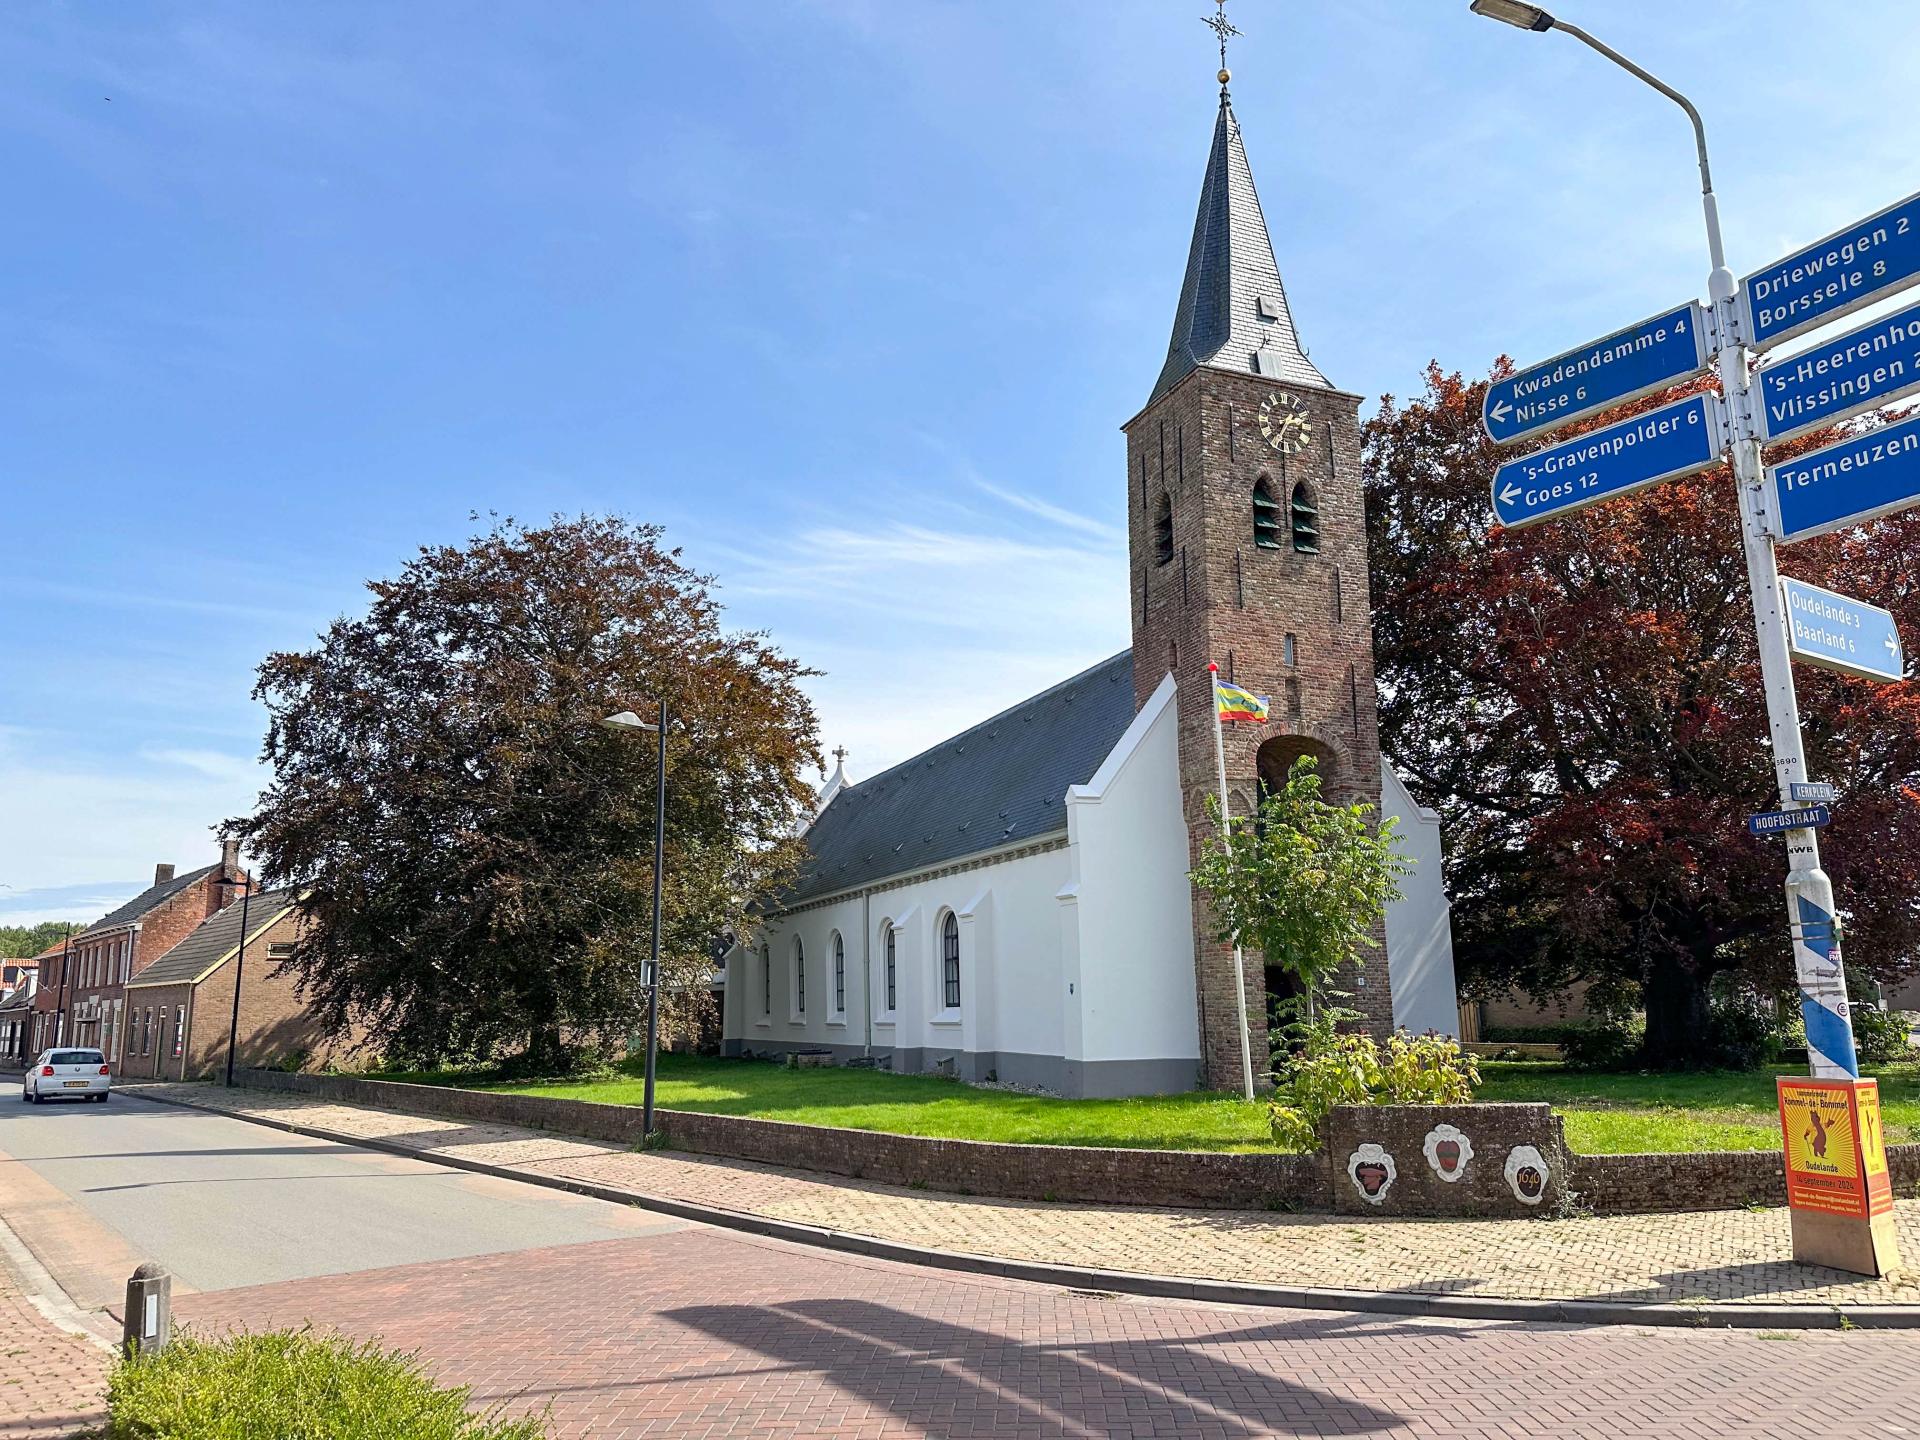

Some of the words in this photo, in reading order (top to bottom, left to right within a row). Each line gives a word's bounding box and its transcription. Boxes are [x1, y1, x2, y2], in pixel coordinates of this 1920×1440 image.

[1754, 227, 1887, 301] Driewegen
[1896, 217, 1910, 235] 2
[1758, 271, 1862, 329] Borssele
[1873, 260, 1886, 277] 8
[1513, 328, 1666, 399] Kwadendamme
[1674, 319, 1686, 334] 4
[1516, 395, 1568, 423] Nisse
[1576, 386, 1587, 400] 6
[1771, 360, 1904, 422] Vlissingen
[1522, 415, 1680, 481] 's-Gravenpolder
[1687, 409, 1699, 425] 6
[1781, 433, 1919, 491] Terneuzen
[1525, 481, 1573, 507] Goes
[1579, 472, 1599, 489] 12
[1791, 591, 1852, 626] Oudelande
[1854, 614, 1860, 629] 3
[1795, 619, 1846, 650] Baarland
[1848, 639, 1856, 654] 6
[1796, 785, 1831, 798] KERKPLEIN
[1755, 809, 1820, 830] HOOFDSTRAAT
[1805, 1160, 1839, 1173] Oudelande
[1838, 1180, 1855, 1190] 2024
